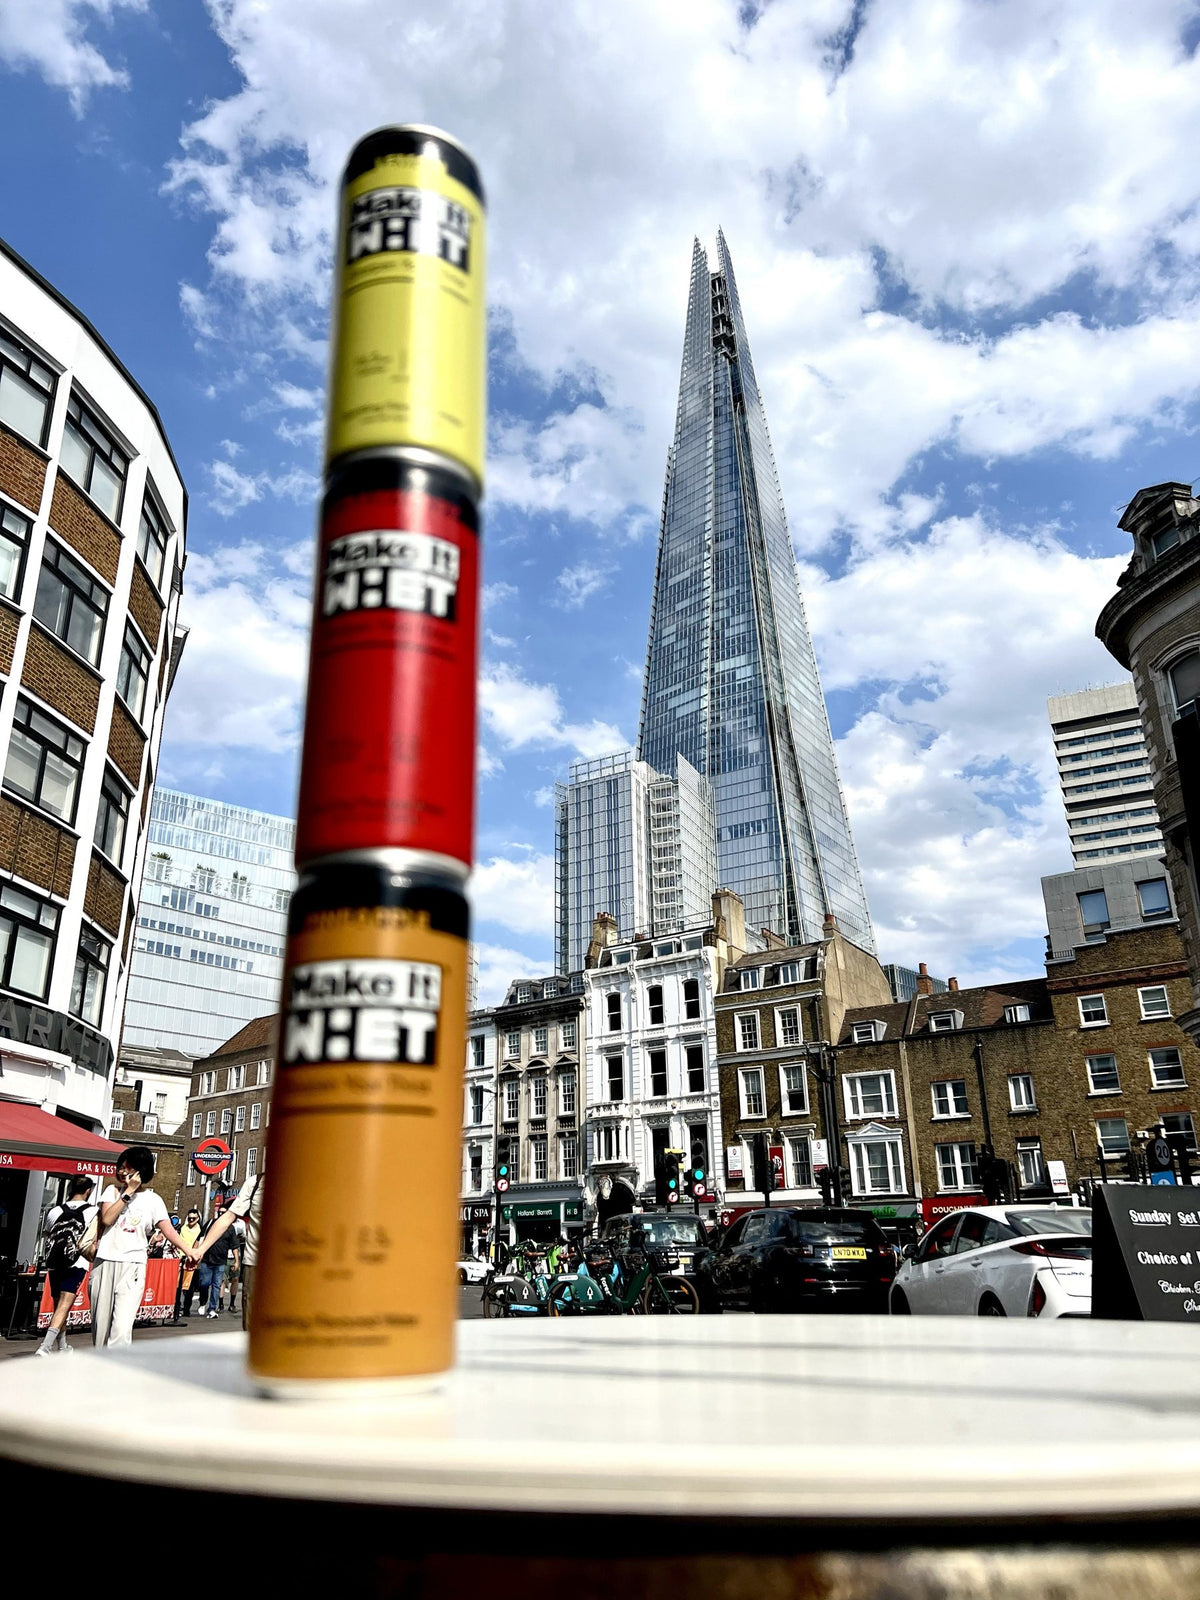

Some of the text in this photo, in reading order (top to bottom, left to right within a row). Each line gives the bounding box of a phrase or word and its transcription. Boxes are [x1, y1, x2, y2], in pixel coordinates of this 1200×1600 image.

[1156, 1144, 1169, 1159] 20
[77, 1162, 93, 1172] BAR
[94, 1164, 99, 1173] &
[474, 1208, 489, 1218] SPA
[517, 1209, 534, 1217] Holland
[1129, 1209, 1171, 1226] Sunday
[1177, 1211, 1198, 1224] Set
[1137, 1251, 1178, 1265] Choice
[1180, 1251, 1193, 1265] of
